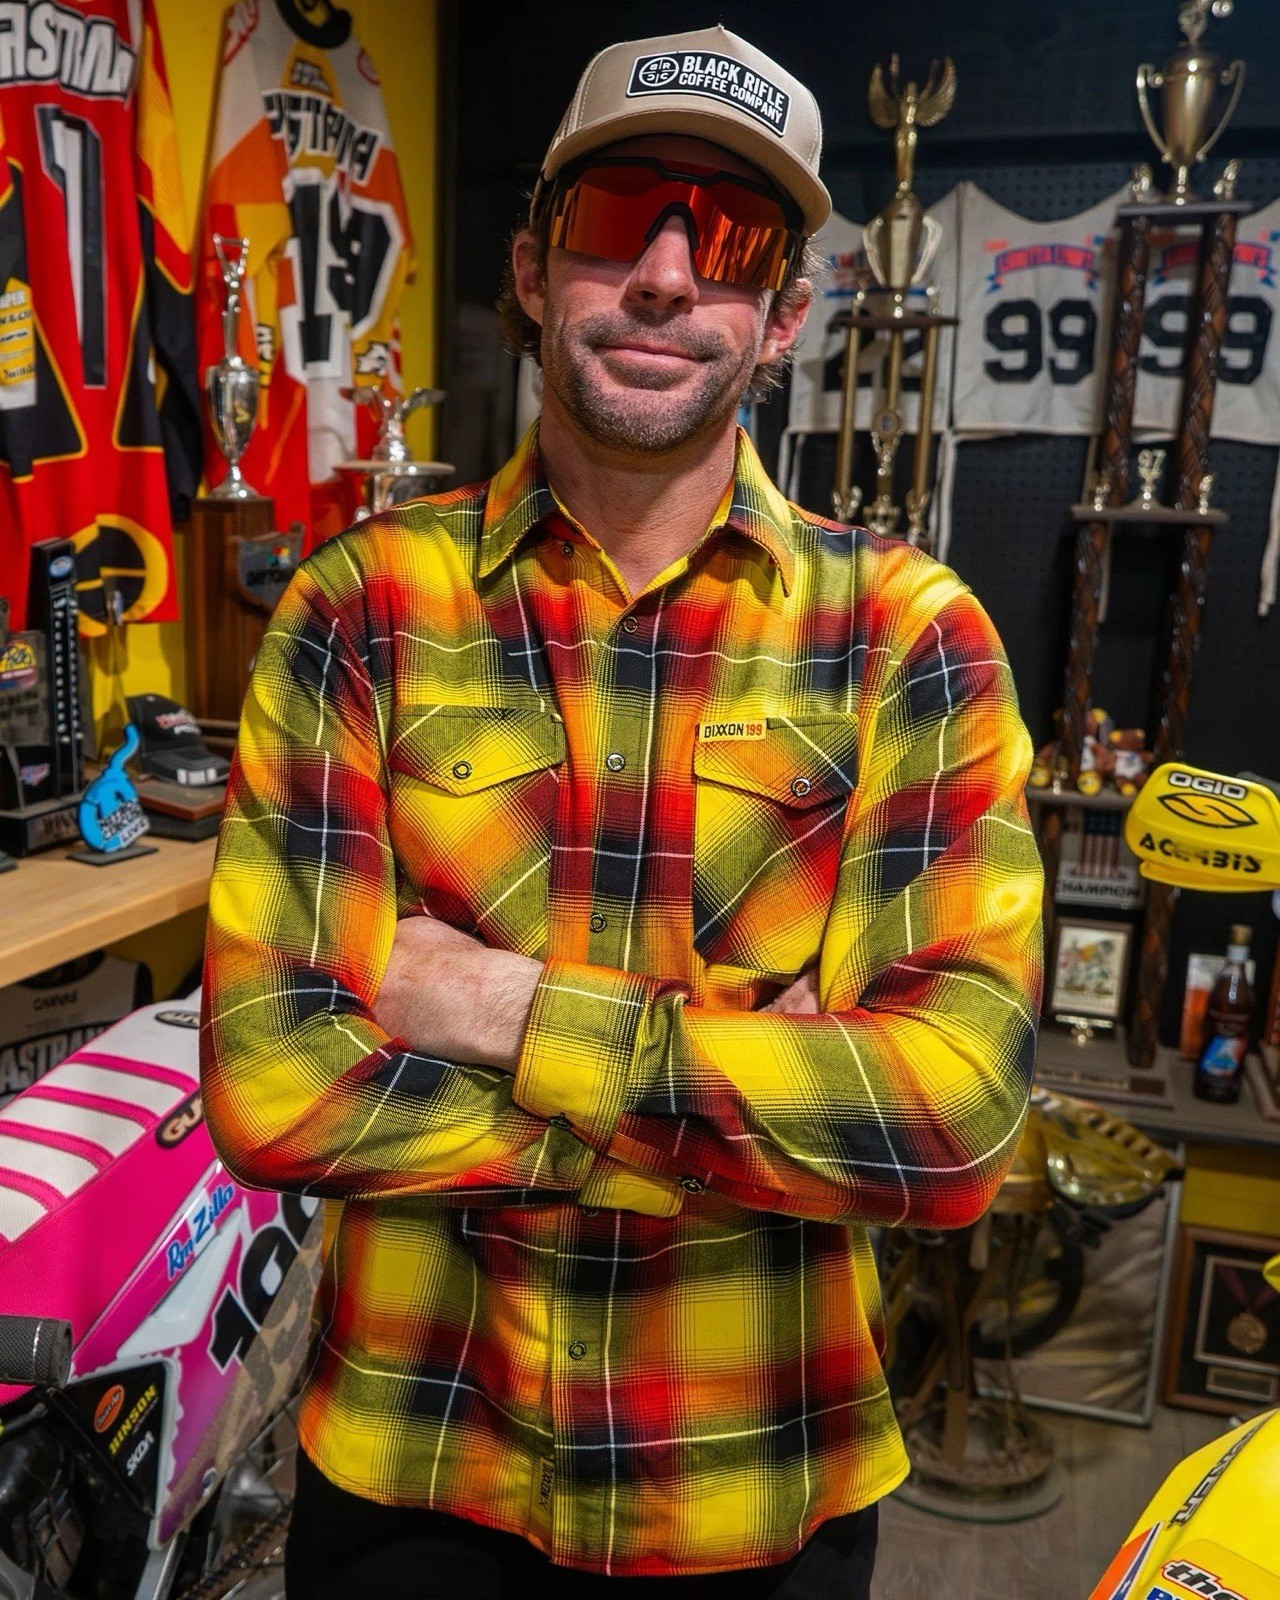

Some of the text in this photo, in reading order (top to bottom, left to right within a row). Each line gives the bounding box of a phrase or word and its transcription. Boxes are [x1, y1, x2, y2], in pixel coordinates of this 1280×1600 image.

[678, 72, 783, 124] COFFEE COMPANY
[682, 55, 786, 112] BLACK RIFLE
[983, 299, 1097, 386] 99
[1139, 294, 1273, 386] 99
[704, 723, 763, 738] DIXXON 199
[1168, 771, 1247, 799] OGIO
